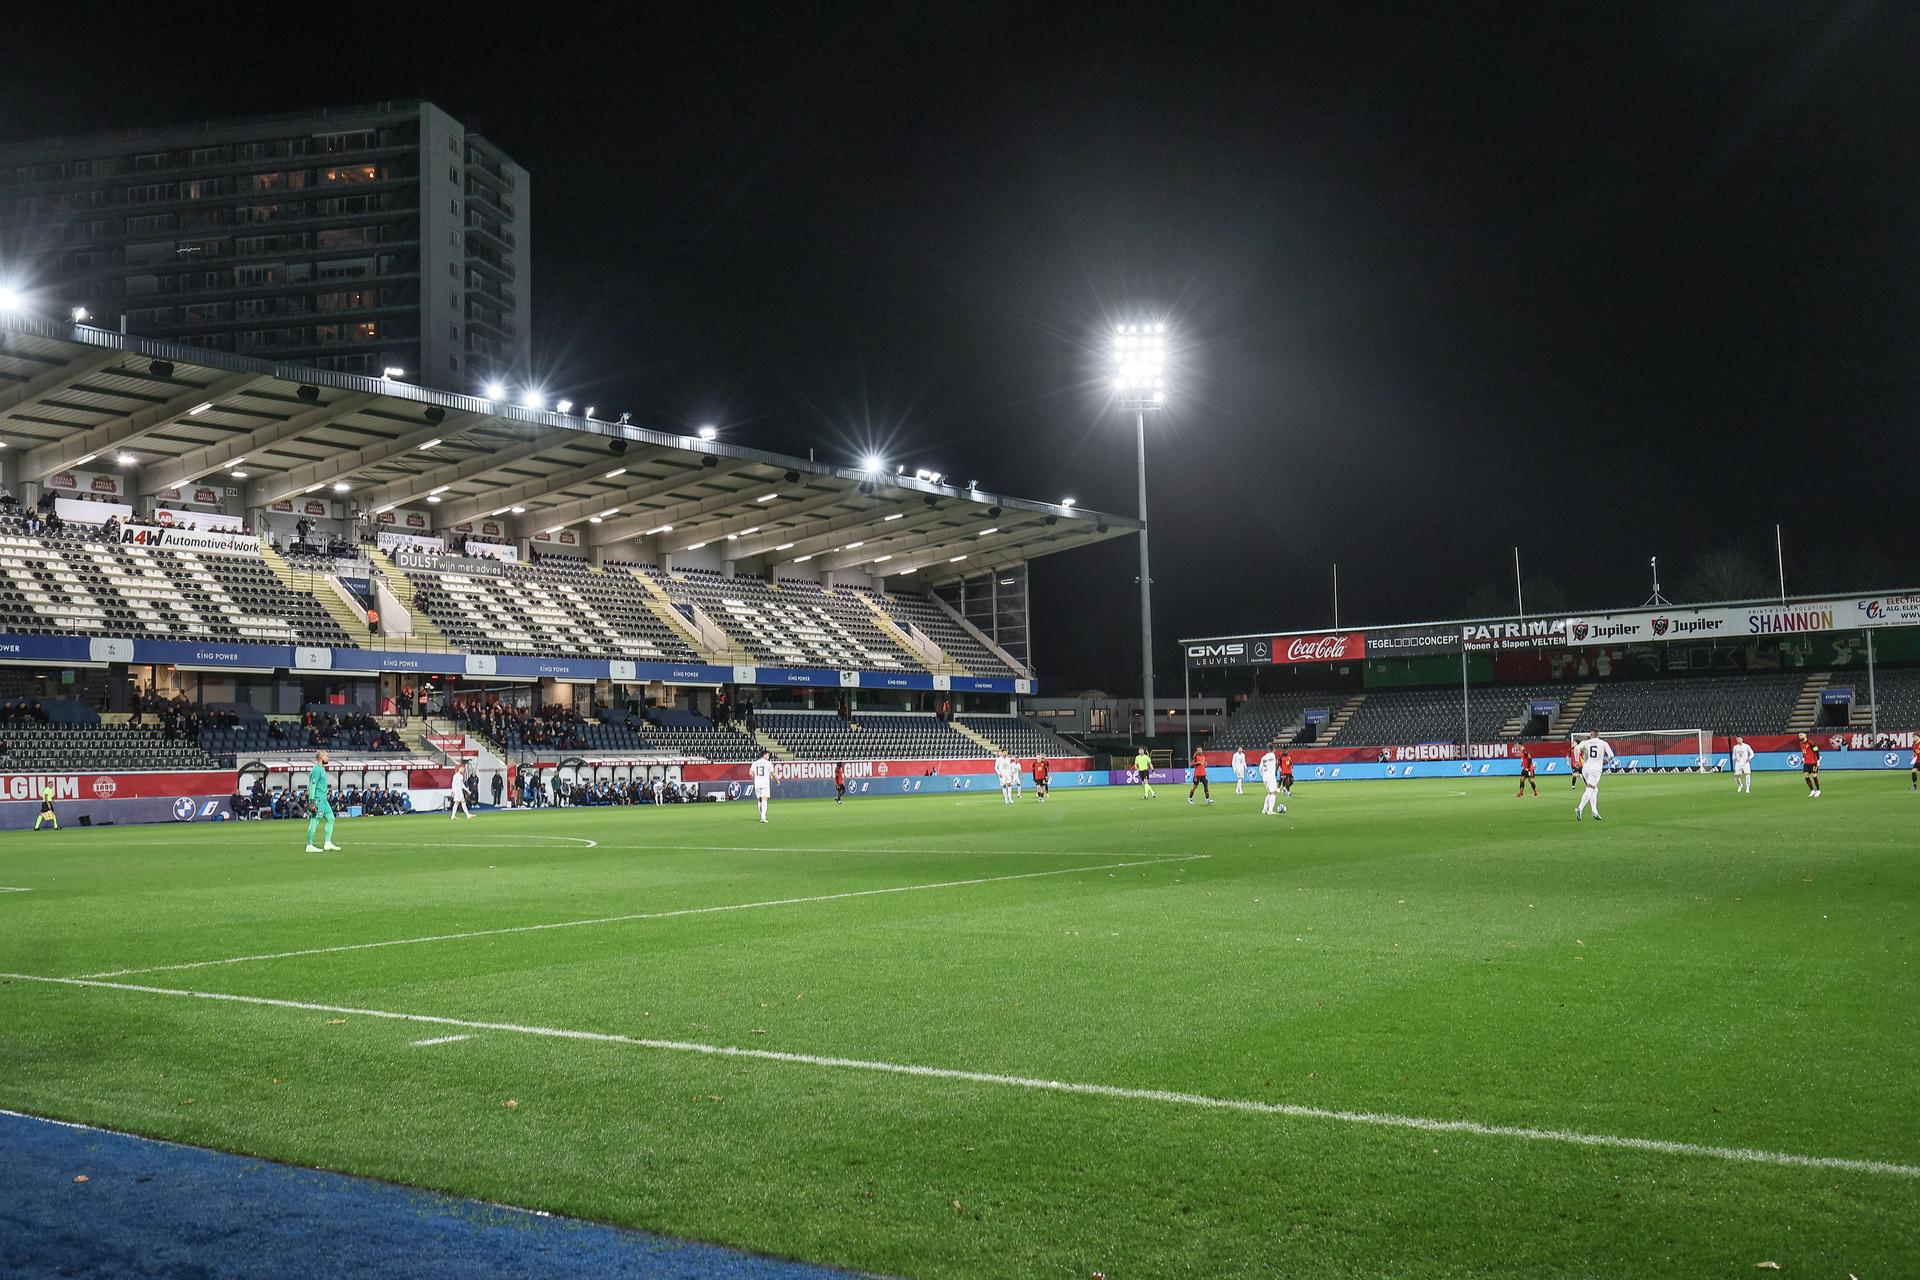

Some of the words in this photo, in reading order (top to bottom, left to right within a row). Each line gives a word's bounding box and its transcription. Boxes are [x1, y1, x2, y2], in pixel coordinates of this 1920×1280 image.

[121, 528, 165, 546] A4W
[164, 534, 260, 553] Automotive4Work
[400, 554, 438, 569] DULST
[439, 561, 456, 573] wijn
[458, 562, 474, 571] met
[476, 562, 501, 575] advies
[1671, 618, 1724, 634] Jupiler
[1749, 610, 1834, 634] SHANNON
[1591, 623, 1641, 639] Jupiler
[1367, 638, 1394, 649] TEGEL
[1418, 634, 1459, 646] CONCEPT
[1464, 642, 1491, 651] Wonen
[1493, 641, 1500, 649] &
[1502, 640, 1530, 650] Slapen
[1532, 636, 1567, 647] VELTEM
[196, 649, 215, 659] KING
[215, 652, 238, 661] POWER
[1188, 643, 1244, 658] GMS
[383, 658, 398, 667] KING
[399, 660, 418, 668] POWER
[540, 665, 552, 673] KING
[1196, 657, 1236, 666] LEUVEN
[1590, 745, 1598, 758] 6
[756, 765, 765, 777] 13
